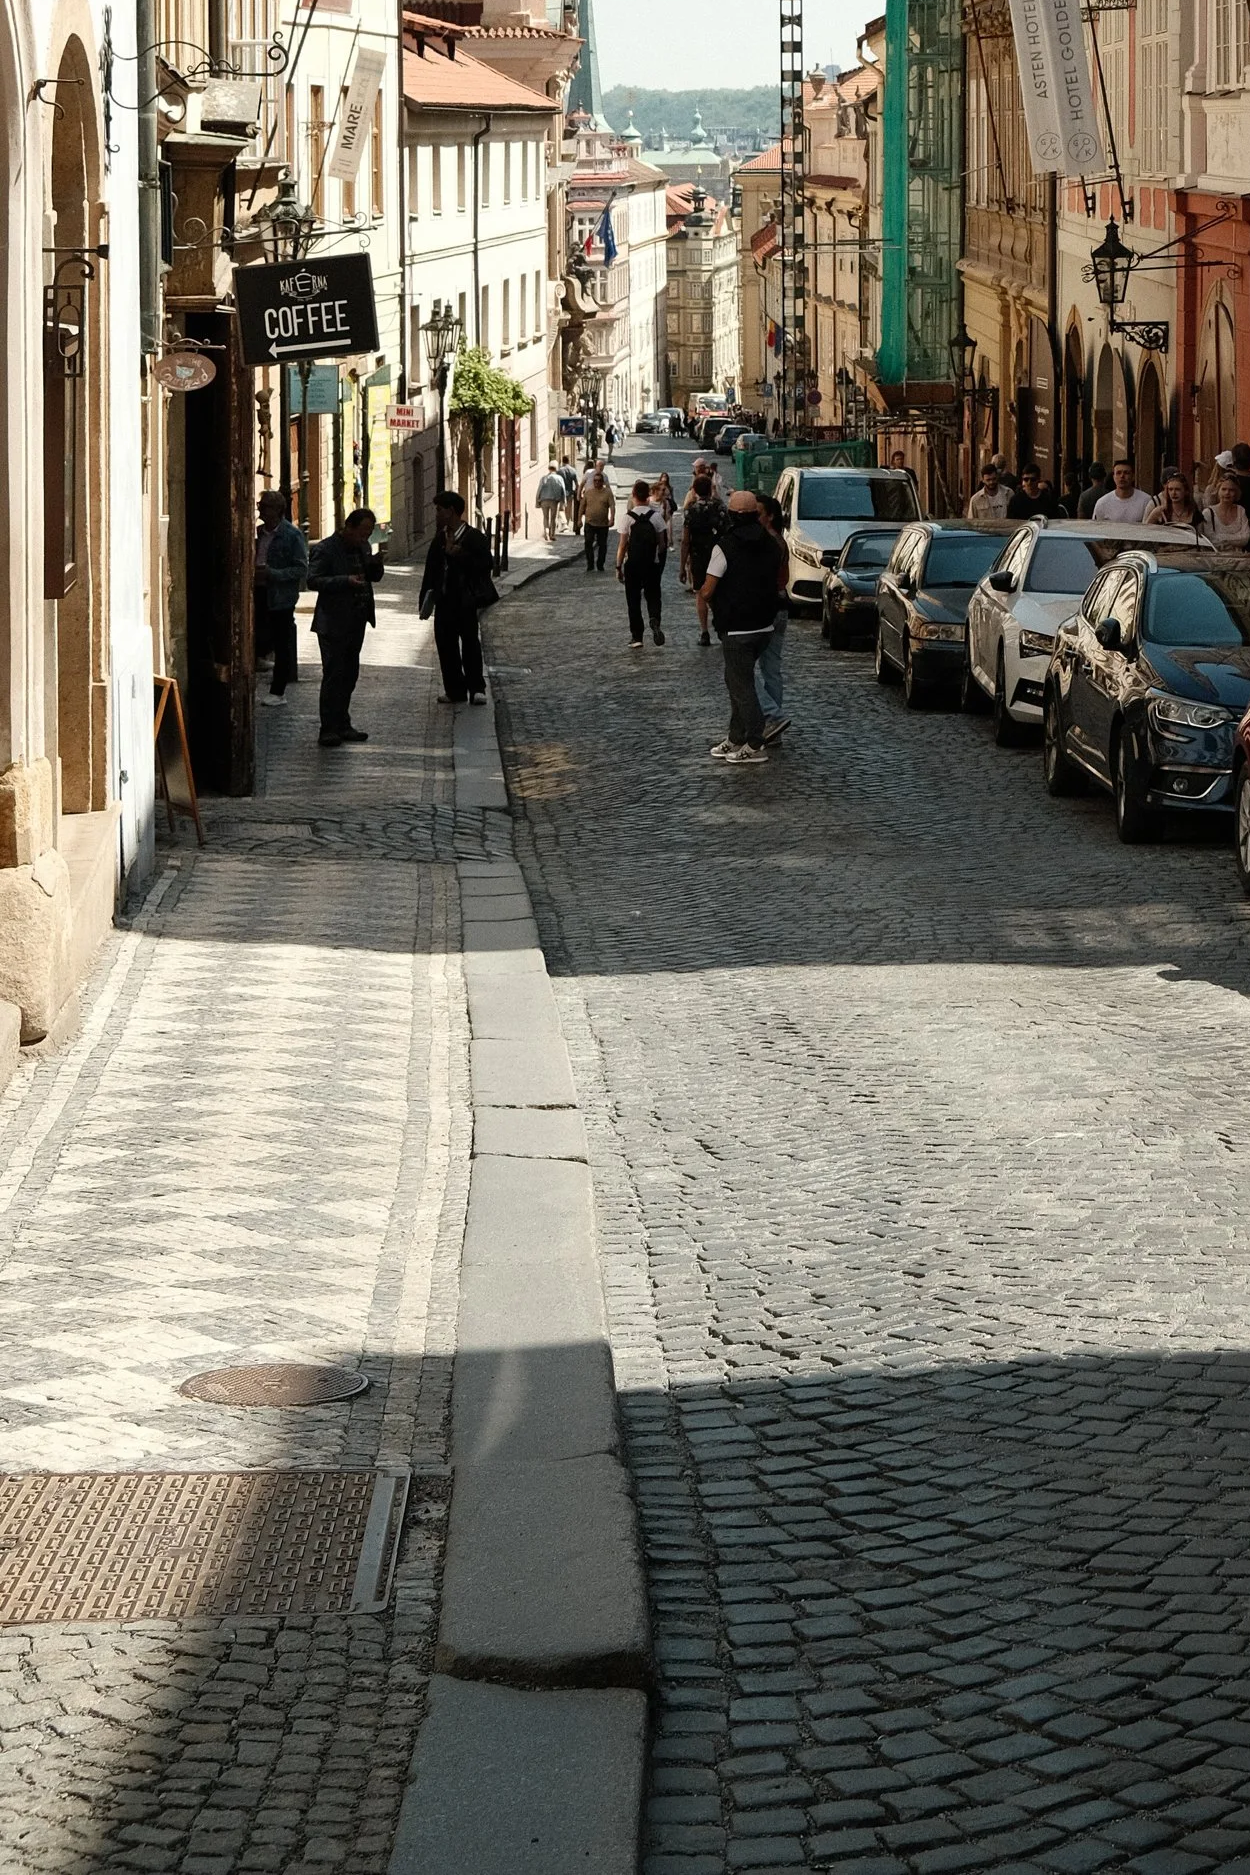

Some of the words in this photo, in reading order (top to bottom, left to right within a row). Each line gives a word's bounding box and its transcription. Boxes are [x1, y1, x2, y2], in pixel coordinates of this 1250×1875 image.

[1031, 50, 1049, 99] ASTEN
[1065, 66, 1083, 121] HOTEL
[279, 268, 328, 293] KAFÉRNA
[264, 300, 350, 339] COFFEE
[389, 418, 420, 428] MARKET
[396, 407, 414, 416] MINI
